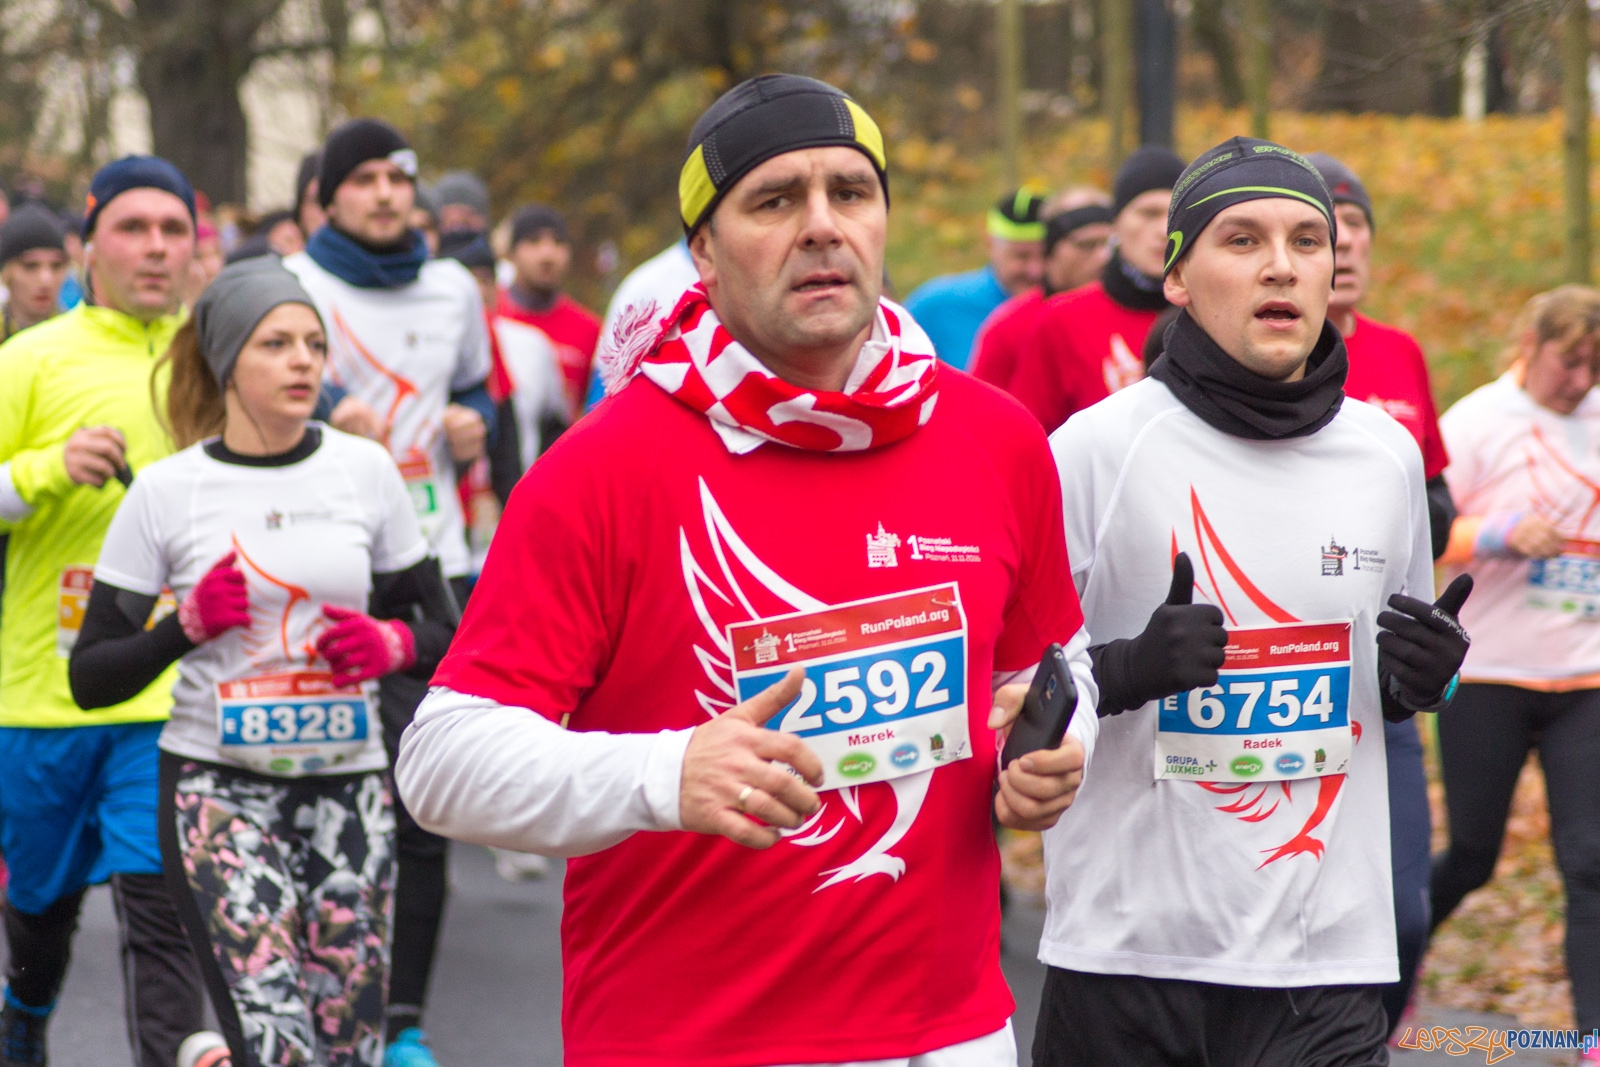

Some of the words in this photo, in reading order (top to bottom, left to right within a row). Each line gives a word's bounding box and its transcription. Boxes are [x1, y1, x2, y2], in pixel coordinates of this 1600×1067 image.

[906, 534, 924, 560] 1
[860, 609, 950, 635] RunPoland.org
[784, 632, 797, 653] 1
[1269, 641, 1339, 655] RunPoland.org
[779, 650, 950, 734] 2592
[1187, 674, 1334, 729] 6754
[240, 703, 356, 744] 8328
[848, 728, 895, 747] Marek
[1243, 738, 1283, 749] Radek
[1166, 755, 1198, 766] GRUPA
[1166, 765, 1205, 775] LUXMED
